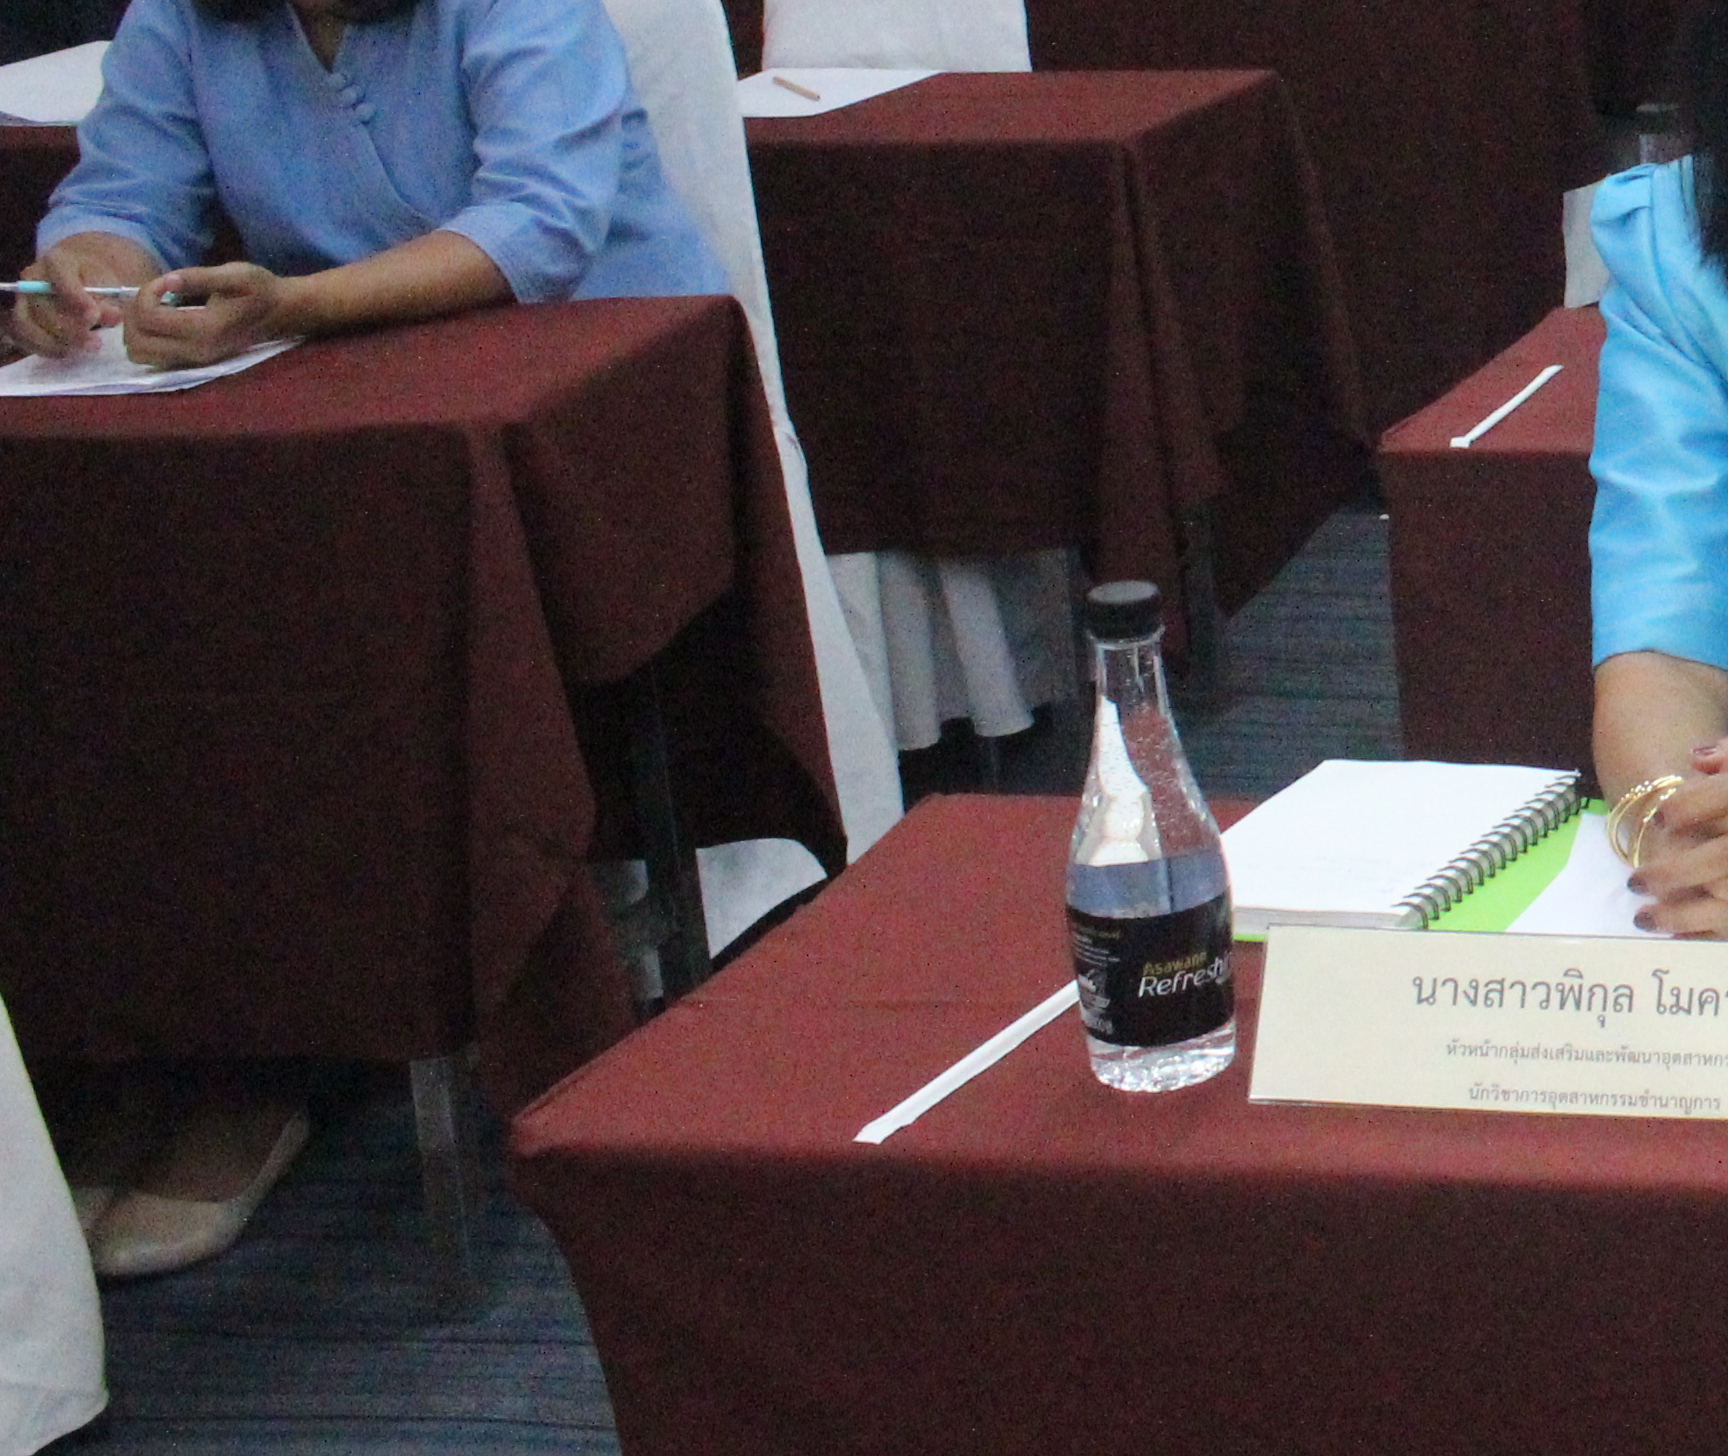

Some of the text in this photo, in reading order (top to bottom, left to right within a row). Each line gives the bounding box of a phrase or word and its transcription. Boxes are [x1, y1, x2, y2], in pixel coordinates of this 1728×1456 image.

[1411, 967, 1634, 1027] นางสาวพิกุล
[1469, 1083, 1721, 1114] นักวิชาการอุตสาหกรรมชำนาญการ
